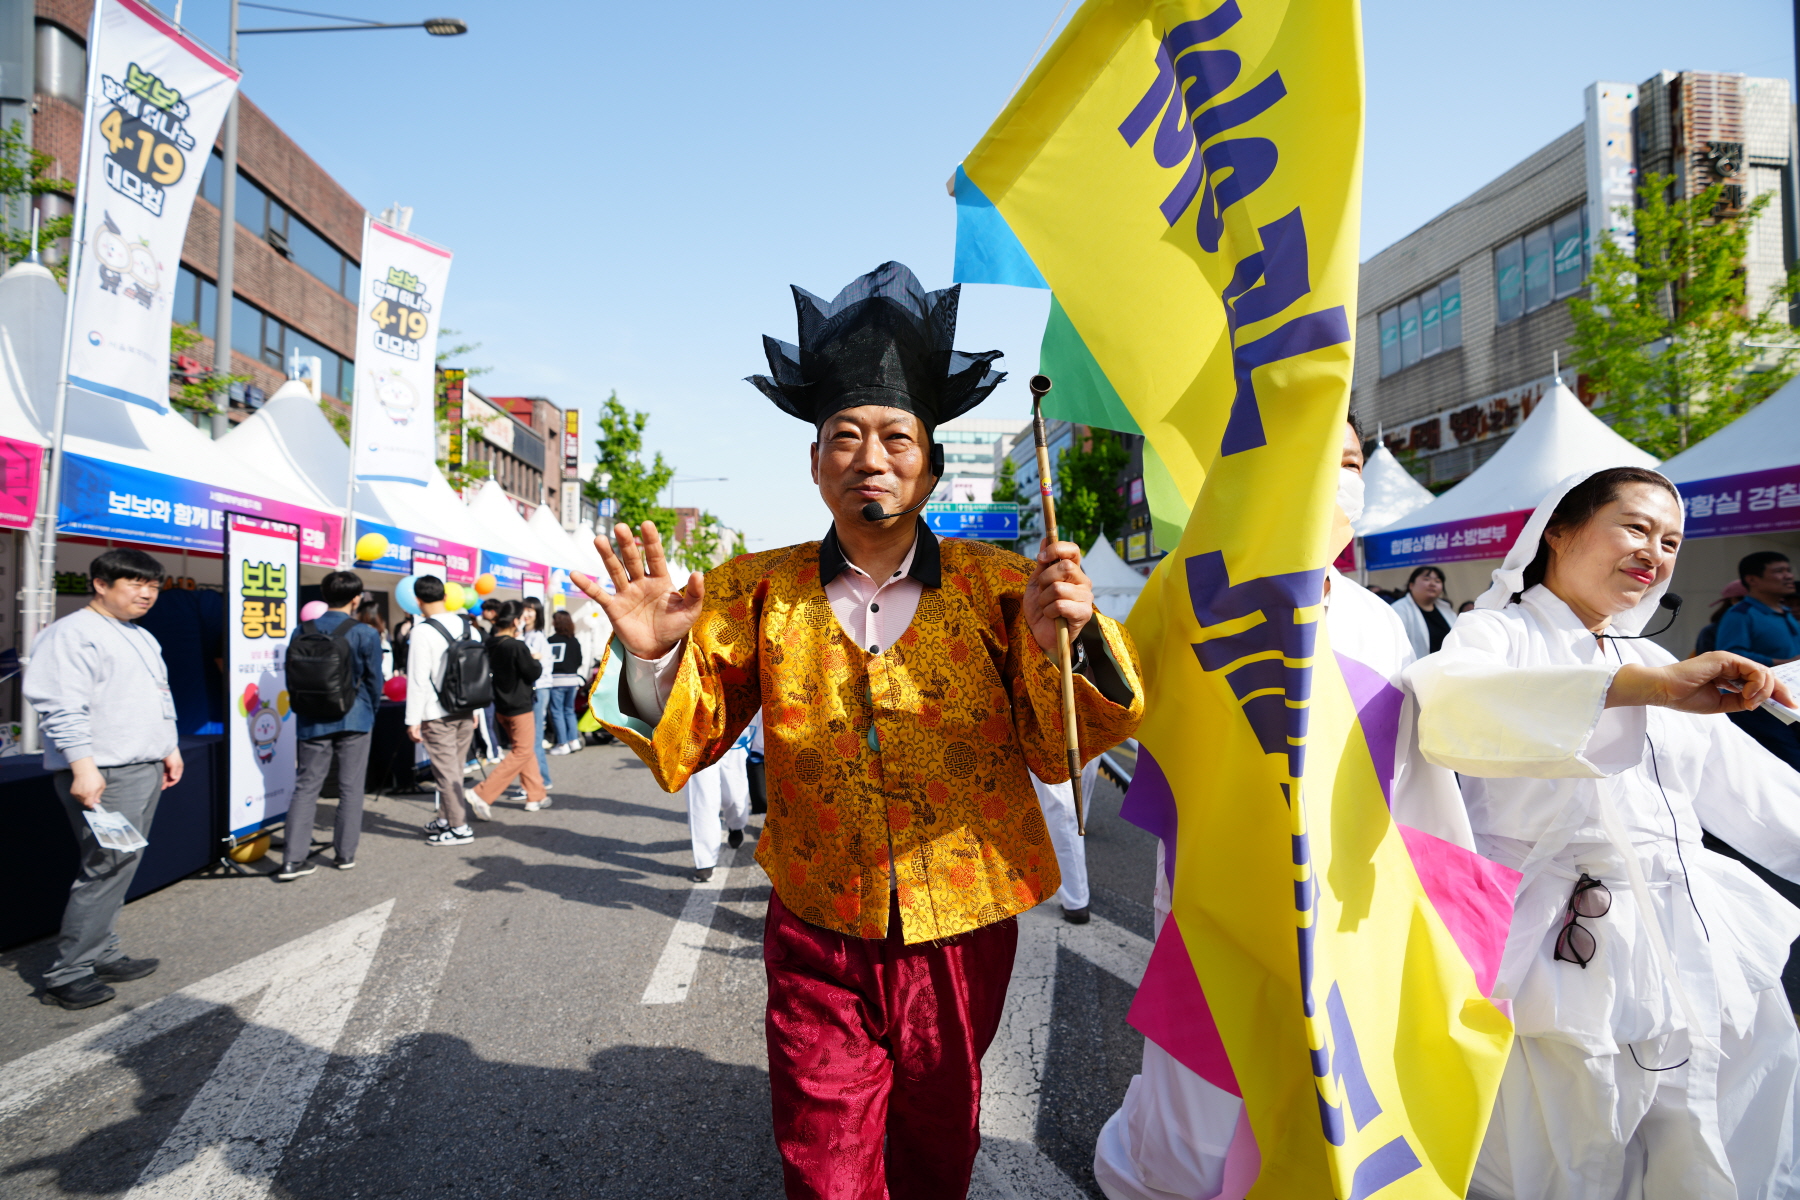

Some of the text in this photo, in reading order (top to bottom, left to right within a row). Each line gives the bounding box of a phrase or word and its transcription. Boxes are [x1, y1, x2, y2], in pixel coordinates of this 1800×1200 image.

[125, 62, 190, 121] 보보와
[141, 104, 196, 152] 떠나는
[103, 154, 166, 218] 대모험
[374, 331, 420, 360] 대모험
[108, 490, 171, 523] 보보와
[173, 503, 209, 529] 함께
[1391, 524, 1507, 555] 합동상황실 소방본부
[241, 559, 288, 598] 보보
[242, 600, 287, 638] 풍선
